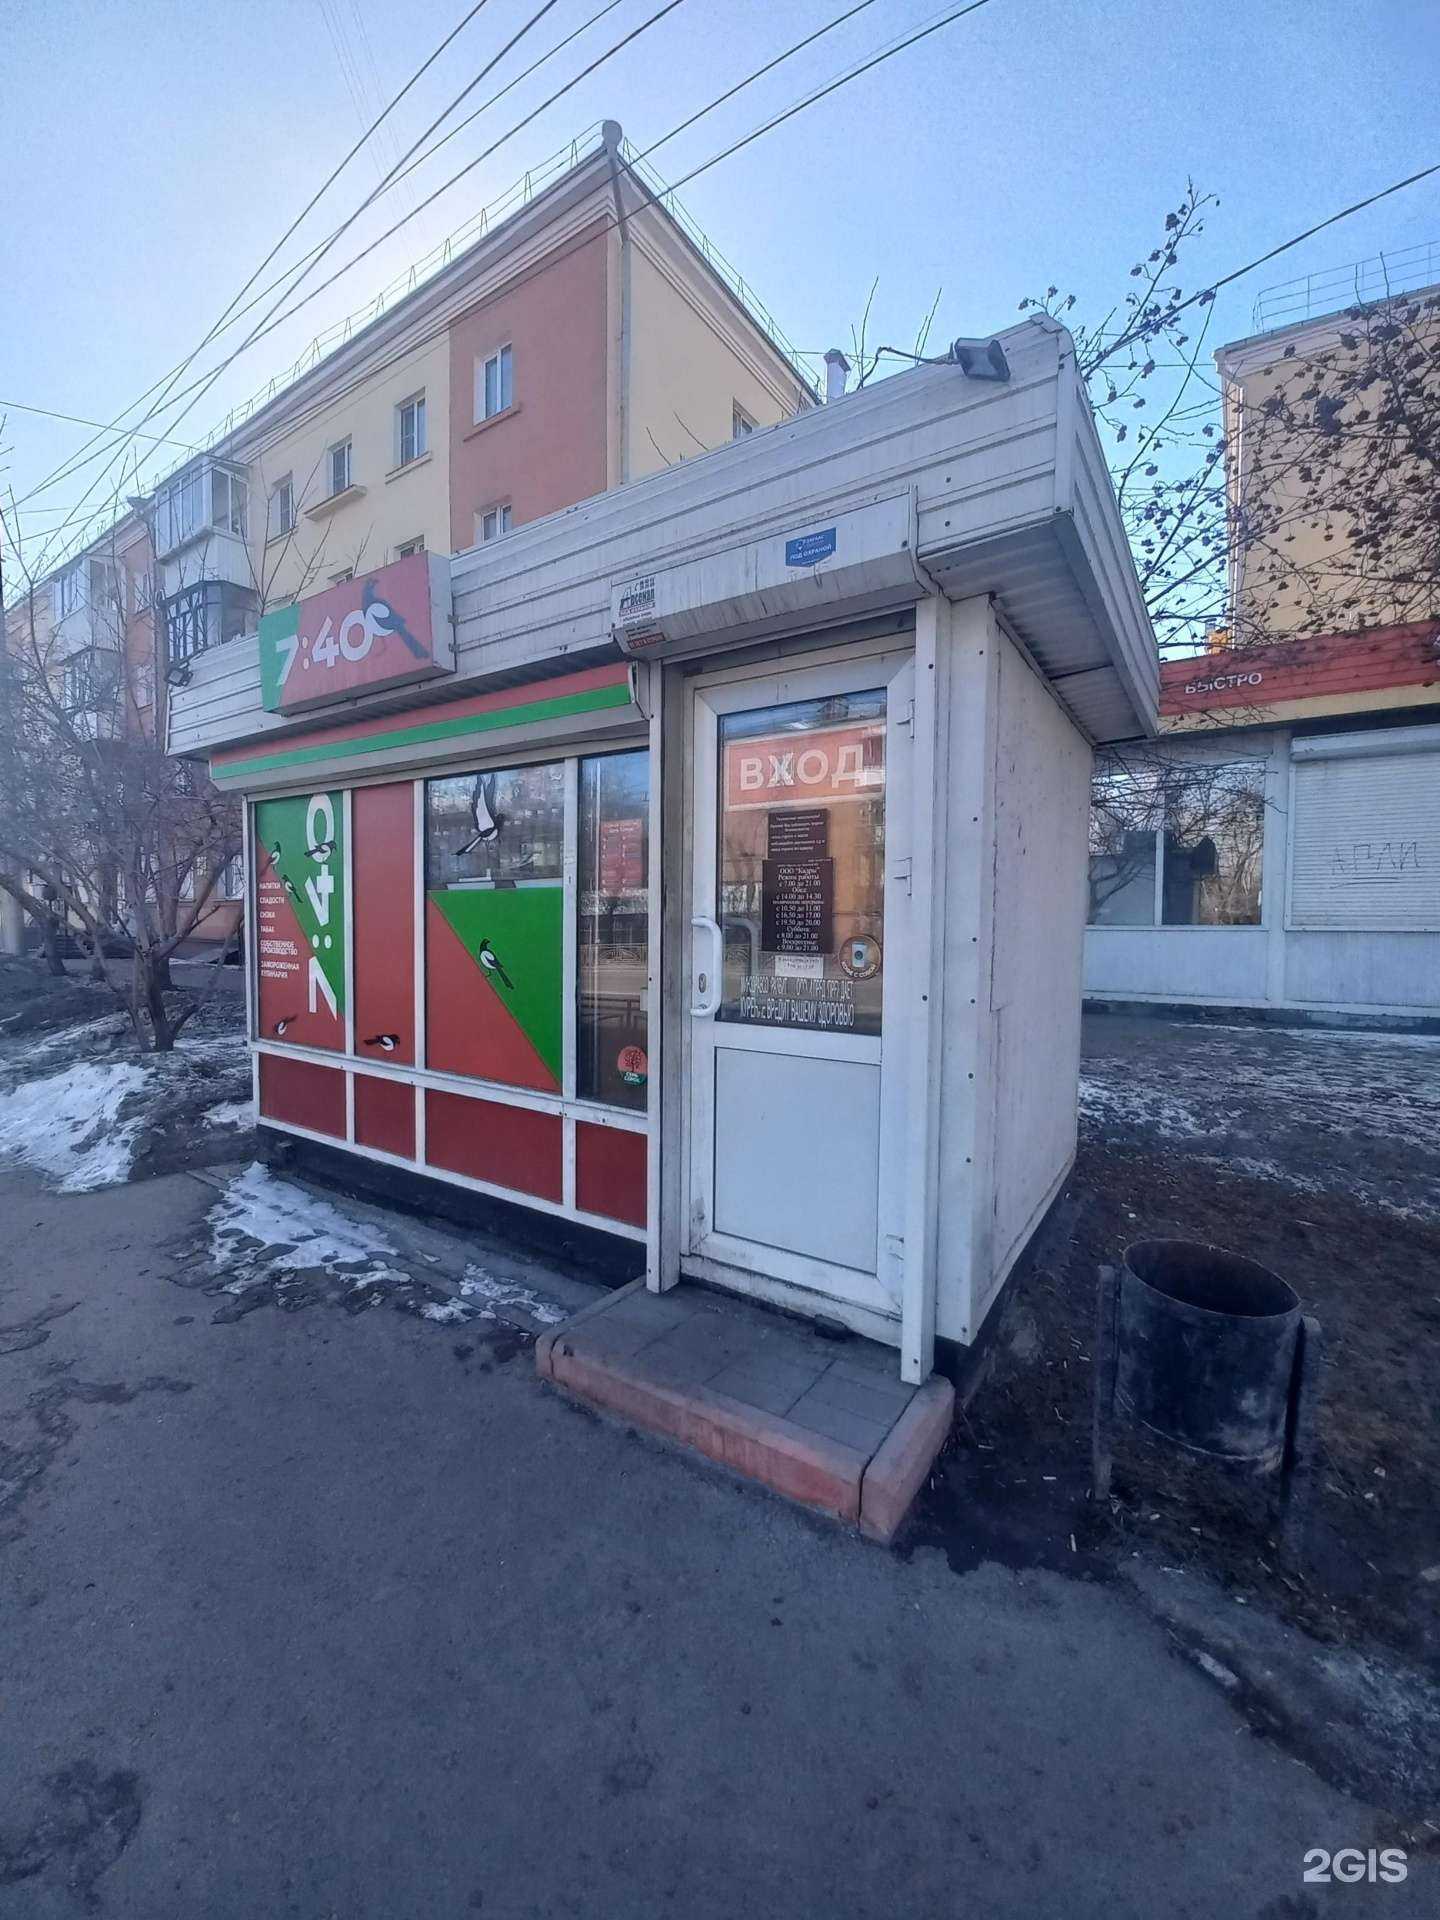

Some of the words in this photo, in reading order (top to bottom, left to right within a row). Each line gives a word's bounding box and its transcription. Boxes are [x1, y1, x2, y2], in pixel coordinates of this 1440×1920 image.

[275, 608, 377, 686] 7:40
[740, 744, 864, 791] ВХОД
[259, 896, 285, 905] СЛАДОСТИ
[818, 1001, 855, 1029] ЗДОРОВЬЮ
